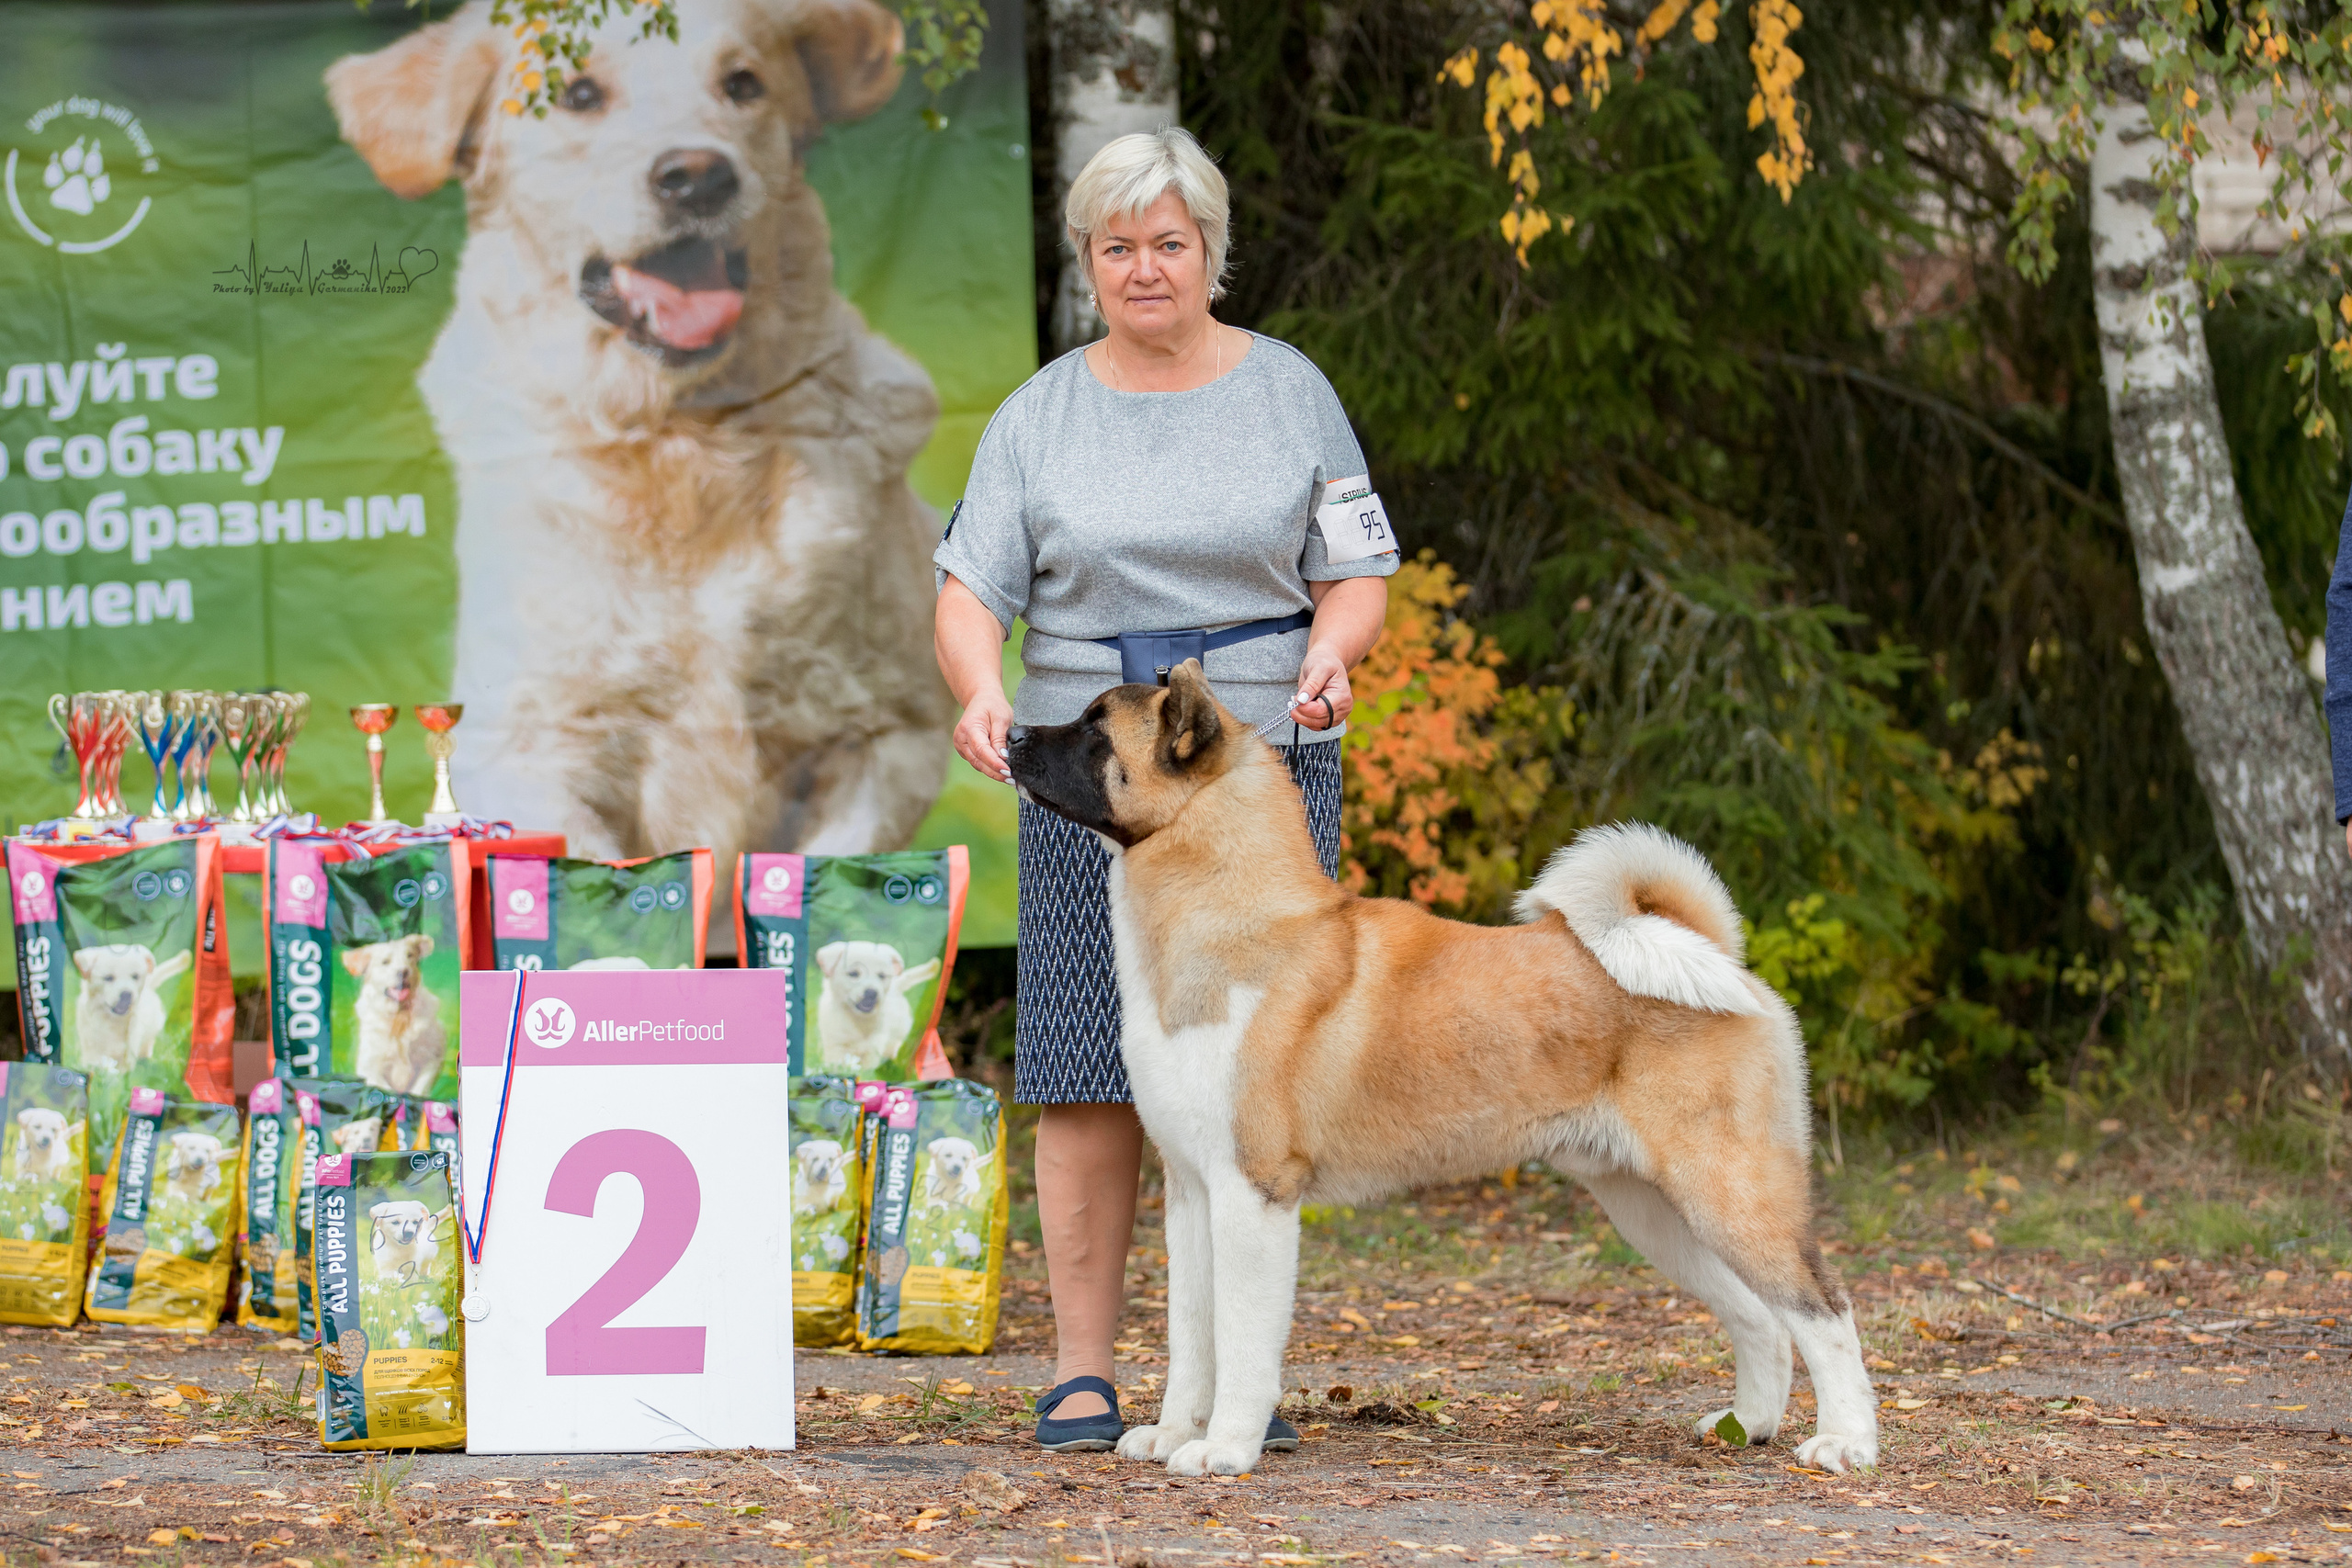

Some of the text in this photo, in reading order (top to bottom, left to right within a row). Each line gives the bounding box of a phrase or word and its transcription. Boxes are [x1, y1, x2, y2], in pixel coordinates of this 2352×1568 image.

[65, 95, 101, 119] dog
[101, 102, 133, 128] will
[123, 118, 153, 157] love
[1, 343, 220, 421] луйте
[24, 415, 286, 486] собаку
[0, 491, 427, 565] ообразным
[1360, 510, 1385, 540] 95
[1, 578, 195, 631] нием
[26, 936, 52, 1057] PUPPIES
[288, 939, 323, 1040] DOGS
[582, 1019, 725, 1042] AllerPetfood
[126, 1119, 155, 1187] PUPPIES
[253, 1118, 280, 1218] ALL DOGS
[882, 1133, 910, 1235] ALL PUPPIES
[122, 1189, 143, 1220] ALL
[326, 1195, 348, 1274] PUPPIES
[544, 1128, 707, 1376] 2
[330, 1277, 349, 1314] ALL
[373, 1356, 408, 1365] PUPPIES
